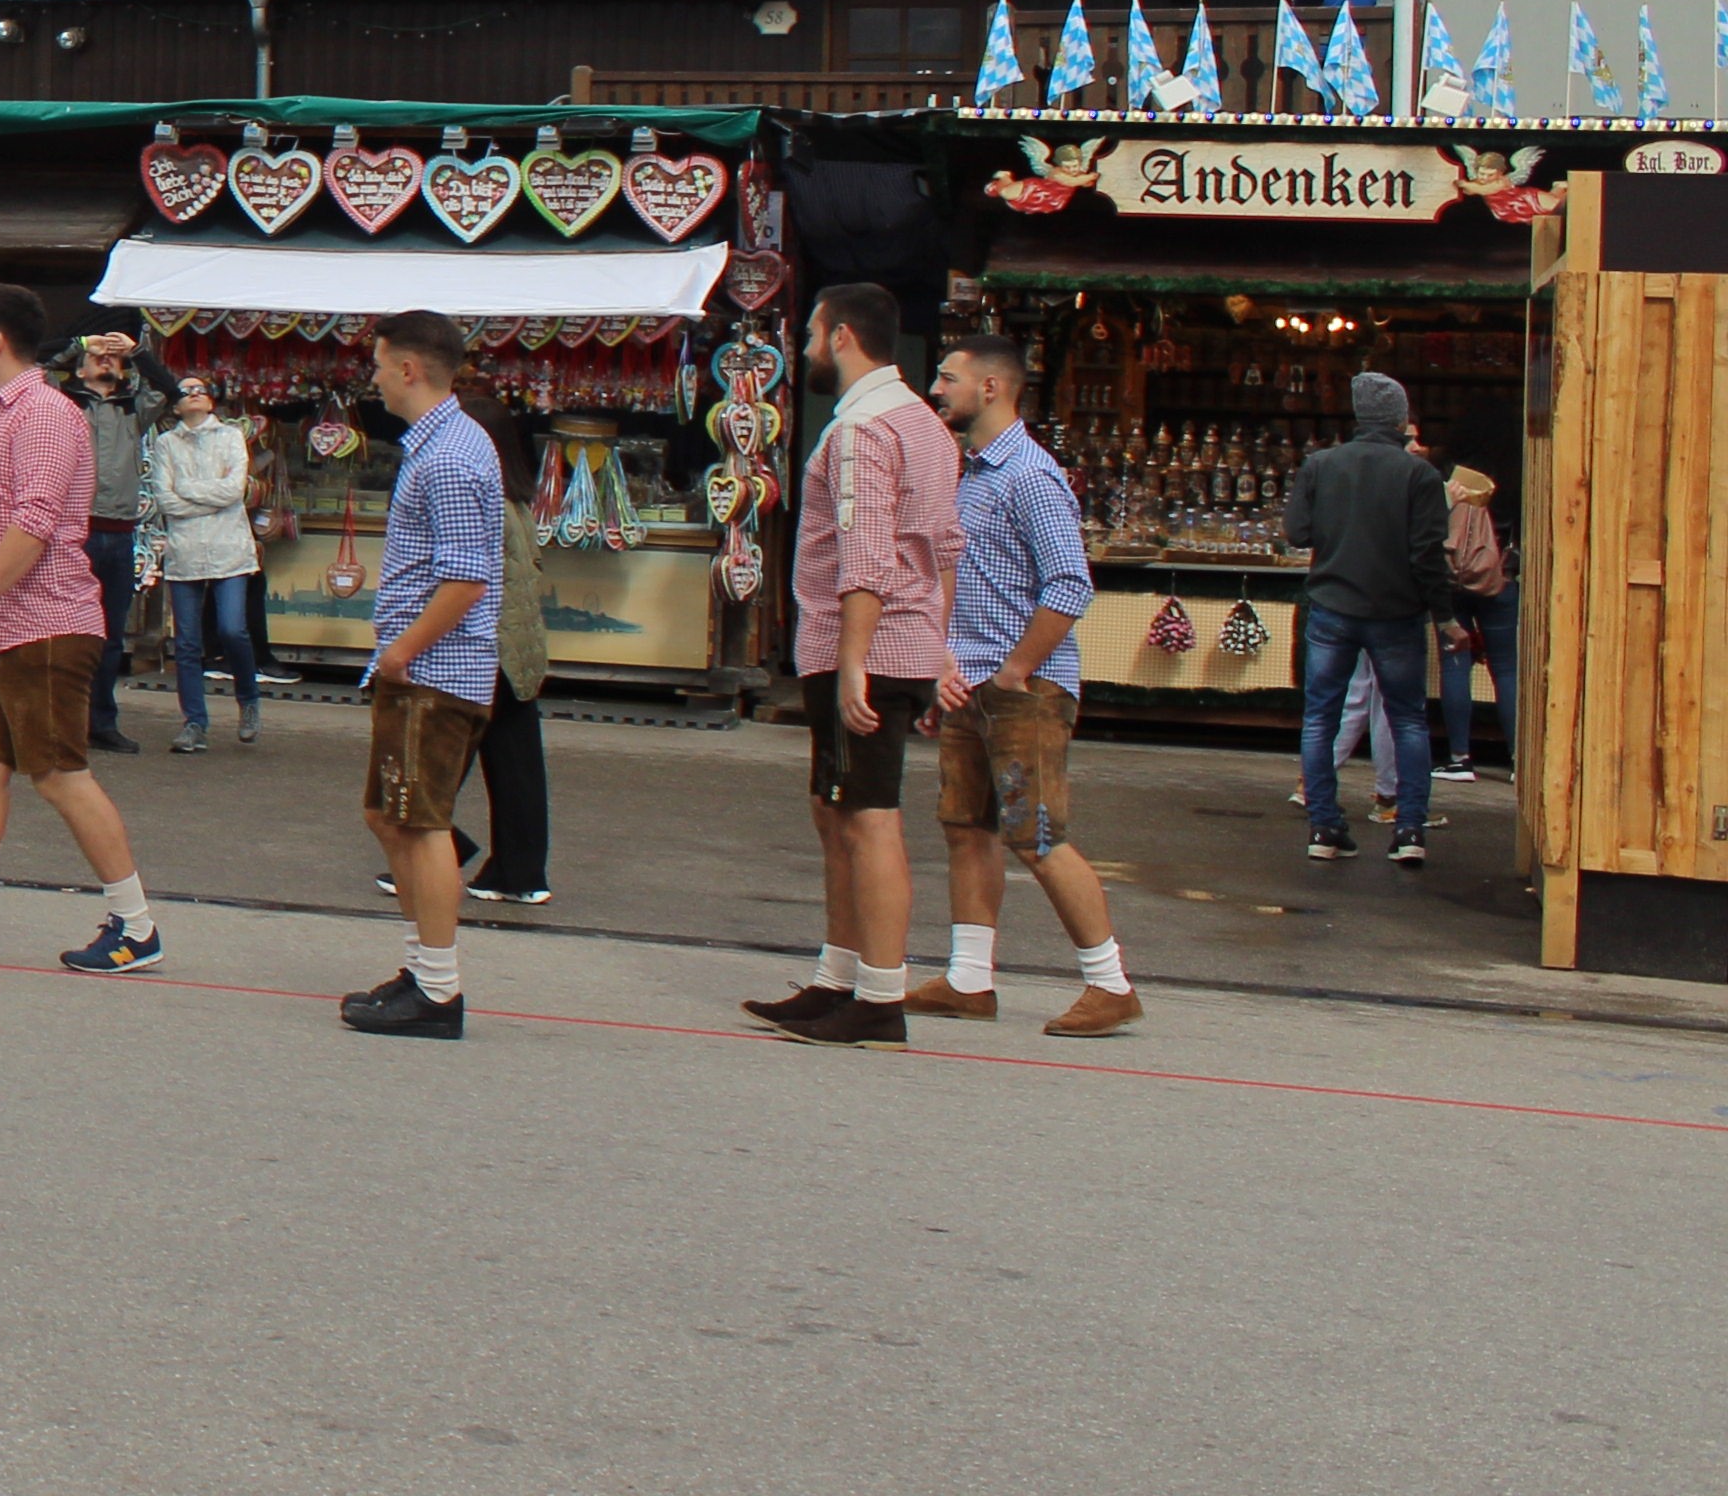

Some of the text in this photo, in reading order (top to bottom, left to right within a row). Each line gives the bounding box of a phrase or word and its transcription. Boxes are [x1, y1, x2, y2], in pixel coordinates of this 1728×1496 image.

[149, 159, 178, 177] Ich
[1636, 151, 1666, 174] Kgl.
[155, 173, 189, 192] liebe
[449, 179, 497, 197] Du bist
[1139, 148, 1416, 210] Andenken
[162, 186, 198, 207] Dich
[108, 946, 136, 967] N
